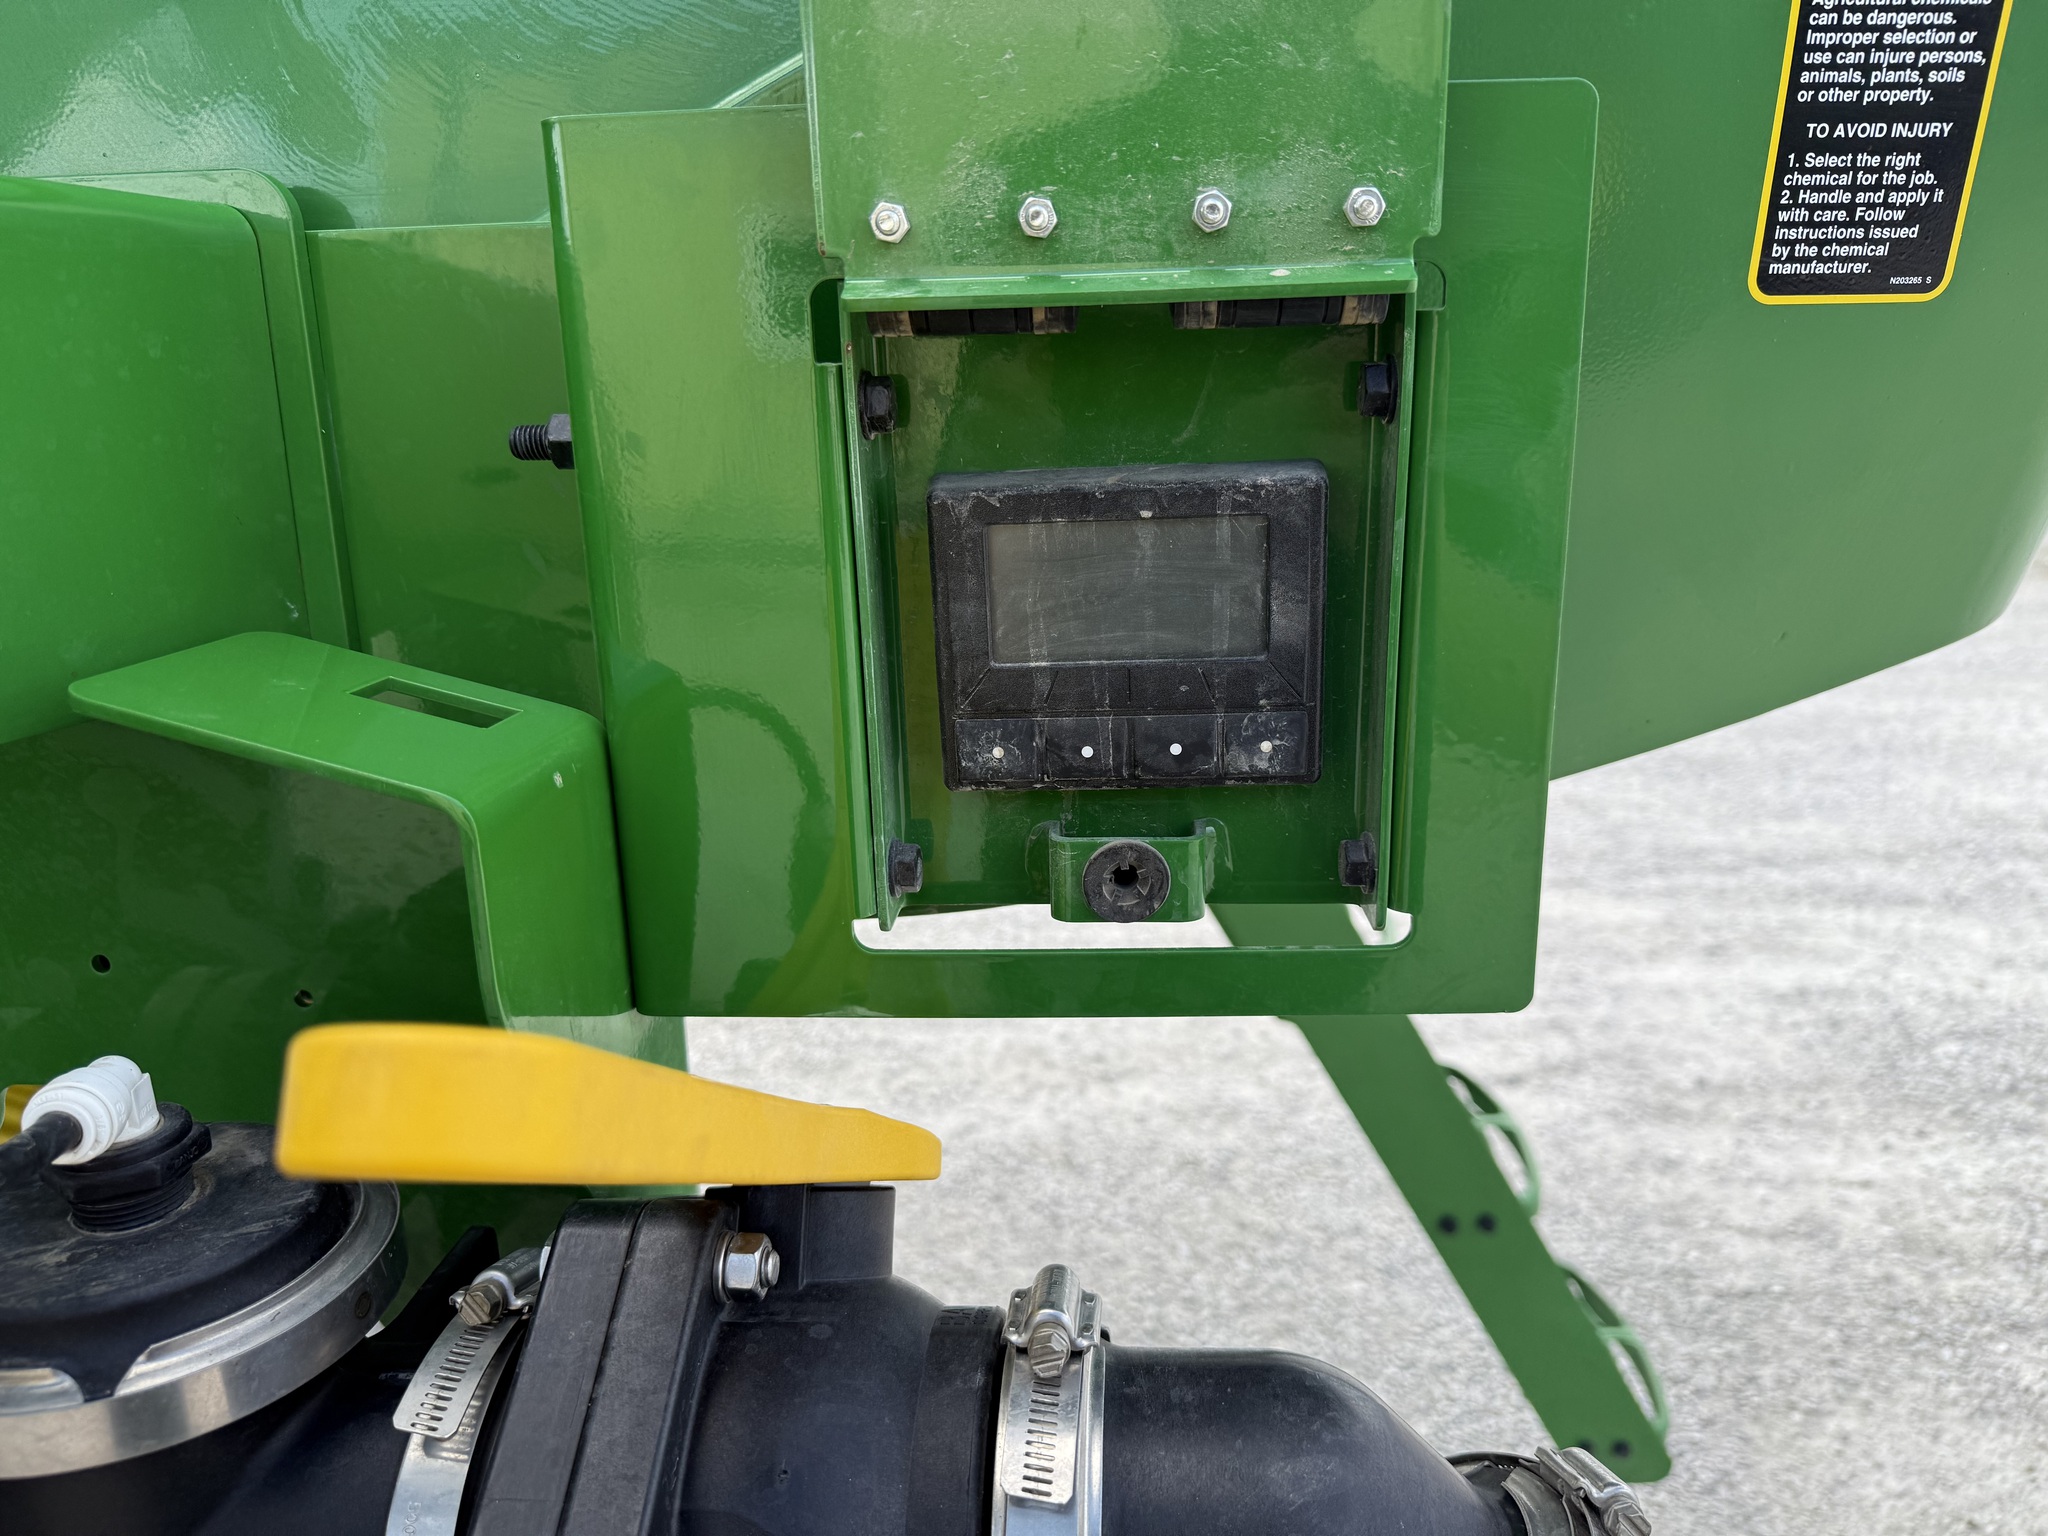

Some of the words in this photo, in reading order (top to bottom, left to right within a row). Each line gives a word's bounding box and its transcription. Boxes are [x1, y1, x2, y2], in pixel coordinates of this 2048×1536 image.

[1809, 12, 1838, 25] can
[1842, 9, 1863, 25] be
[1866, 9, 1957, 29] dangerous.
[1806, 29, 1880, 48] Improper
[1882, 28, 1956, 45] selection
[1959, 31, 1978, 44] or
[1803, 52, 1832, 64] use
[1836, 51, 1865, 64] can
[1869, 48, 1915, 68] injure
[1918, 50, 1986, 67] persons,
[1800, 67, 1865, 86] animals,
[1870, 67, 1923, 87] plants,
[1927, 67, 1966, 83] soils
[1797, 90, 1815, 102] or
[1818, 87, 1861, 102] other
[1863, 87, 1934, 106] property.
[1806, 123, 1829, 138] TO
[1833, 123, 1887, 138] AVOID
[1891, 122, 1954, 138] INJURY
[1788, 153, 1799, 167] 1.
[1804, 152, 1853, 168] Select
[1856, 152, 1881, 167] the
[1885, 152, 1922, 171] right
[1783, 171, 1853, 186] chemical
[1856, 170, 1879, 185] for
[1882, 170, 1906, 185] the
[1908, 170, 1937, 188] job.
[1780, 189, 1793, 204] 2.
[1798, 189, 1852, 204] Handle
[1855, 189, 1885, 203] and
[1888, 188, 1930, 207] apply
[1933, 188, 1944, 203] it
[1778, 207, 1809, 222] with
[1813, 210, 1850, 222] care.
[1855, 206, 1906, 221] Follow
[1775, 225, 1865, 240] instructions
[1869, 224, 1919, 239] issued
[1771, 243, 1791, 261] by
[1794, 243, 1818, 257] the
[1822, 242, 1890, 257] chemical
[1768, 260, 1871, 275] manufacturer.
[1889, 276, 1923, 284] N203265
[1925, 276, 1932, 284] S
